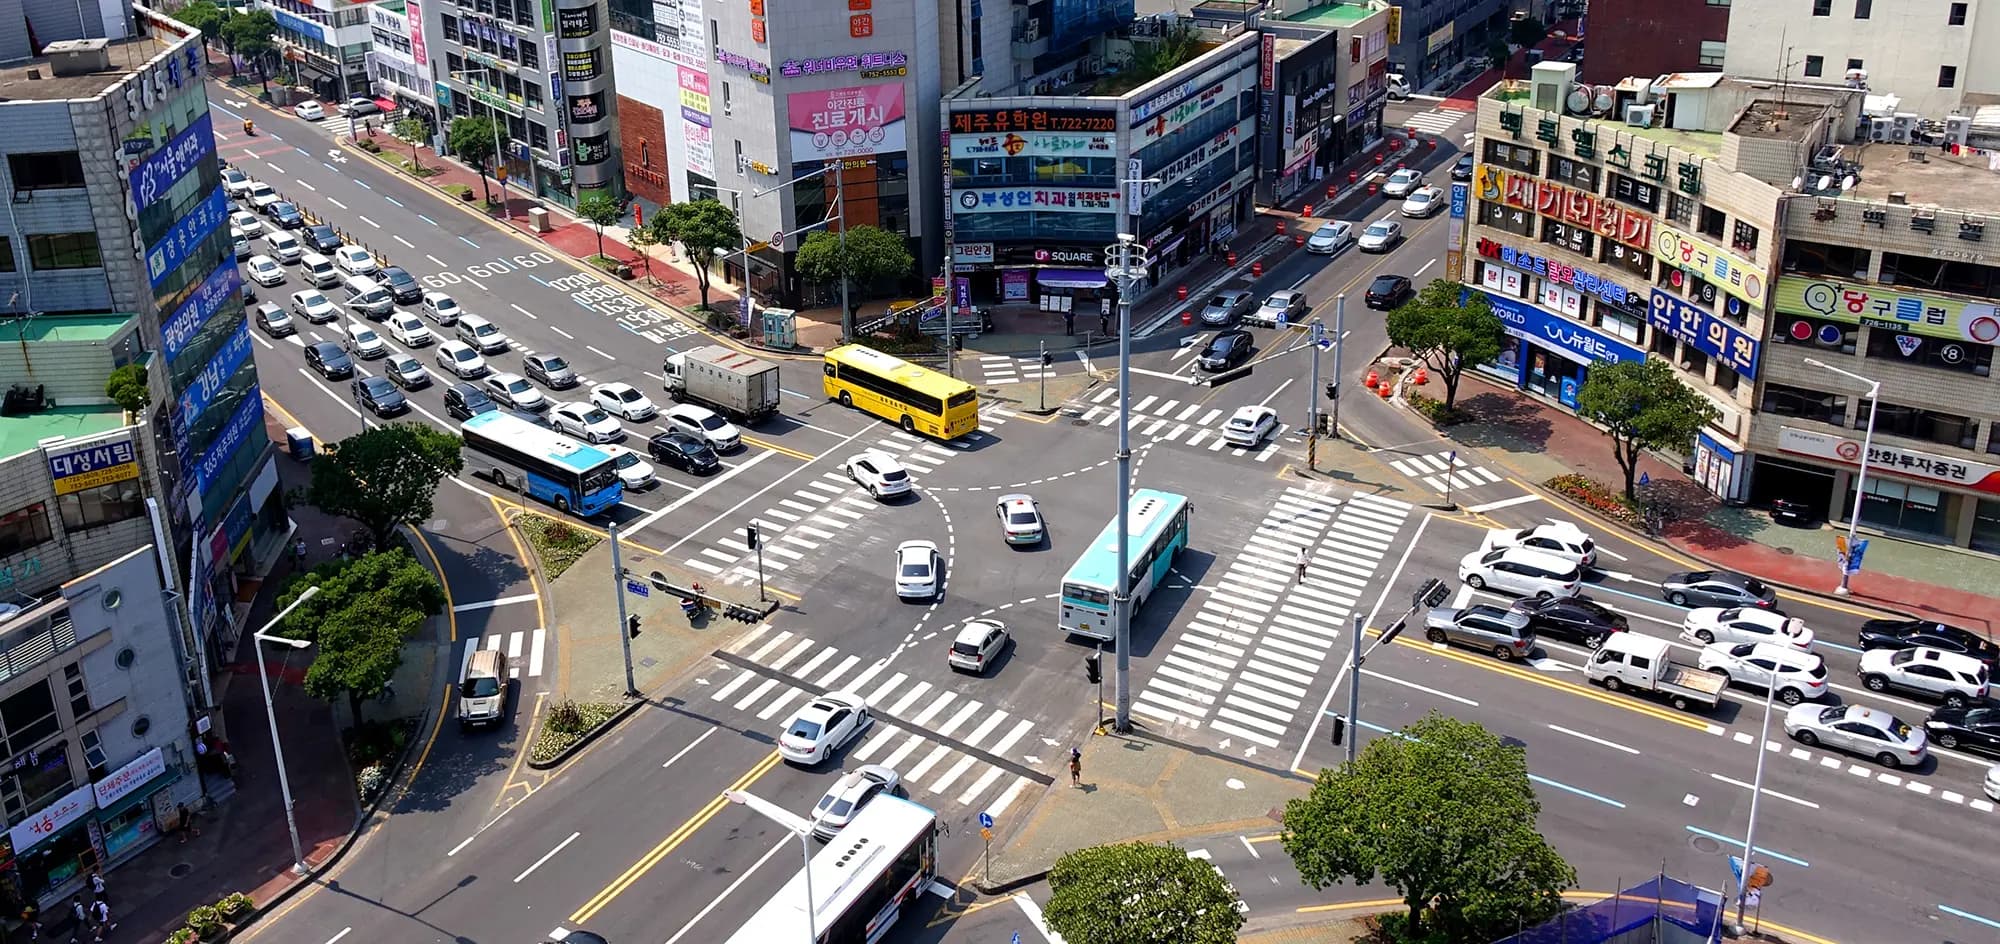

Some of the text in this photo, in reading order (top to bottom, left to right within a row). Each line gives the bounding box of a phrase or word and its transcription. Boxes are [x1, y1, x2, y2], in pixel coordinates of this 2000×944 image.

[803, 51, 905, 74] 워너비우먼 휘트니스
[126, 70, 166, 120] 365
[828, 98, 865, 110] 야간진료
[812, 106, 884, 130] 진료개시
[954, 110, 1114, 132] 제주유학원 T.722-7220
[982, 190, 1066, 207] 부성언치과
[1454, 186, 1465, 212] 안경
[514, 252, 554, 268] 60
[1052, 251, 1093, 262] SQUARE
[1680, 240, 1741, 286] 당구클럽
[422, 272, 462, 288] 60
[467, 261, 510, 278] 60
[1628, 294, 1638, 304] 2F
[1844, 290, 1946, 326] 당구클럽
[165, 300, 200, 352] 광양의원
[1652, 294, 1753, 368] 안한의원
[197, 361, 220, 401] 강남
[53, 443, 130, 475] 대성서림
[1868, 448, 1966, 480] 한화투자증권
